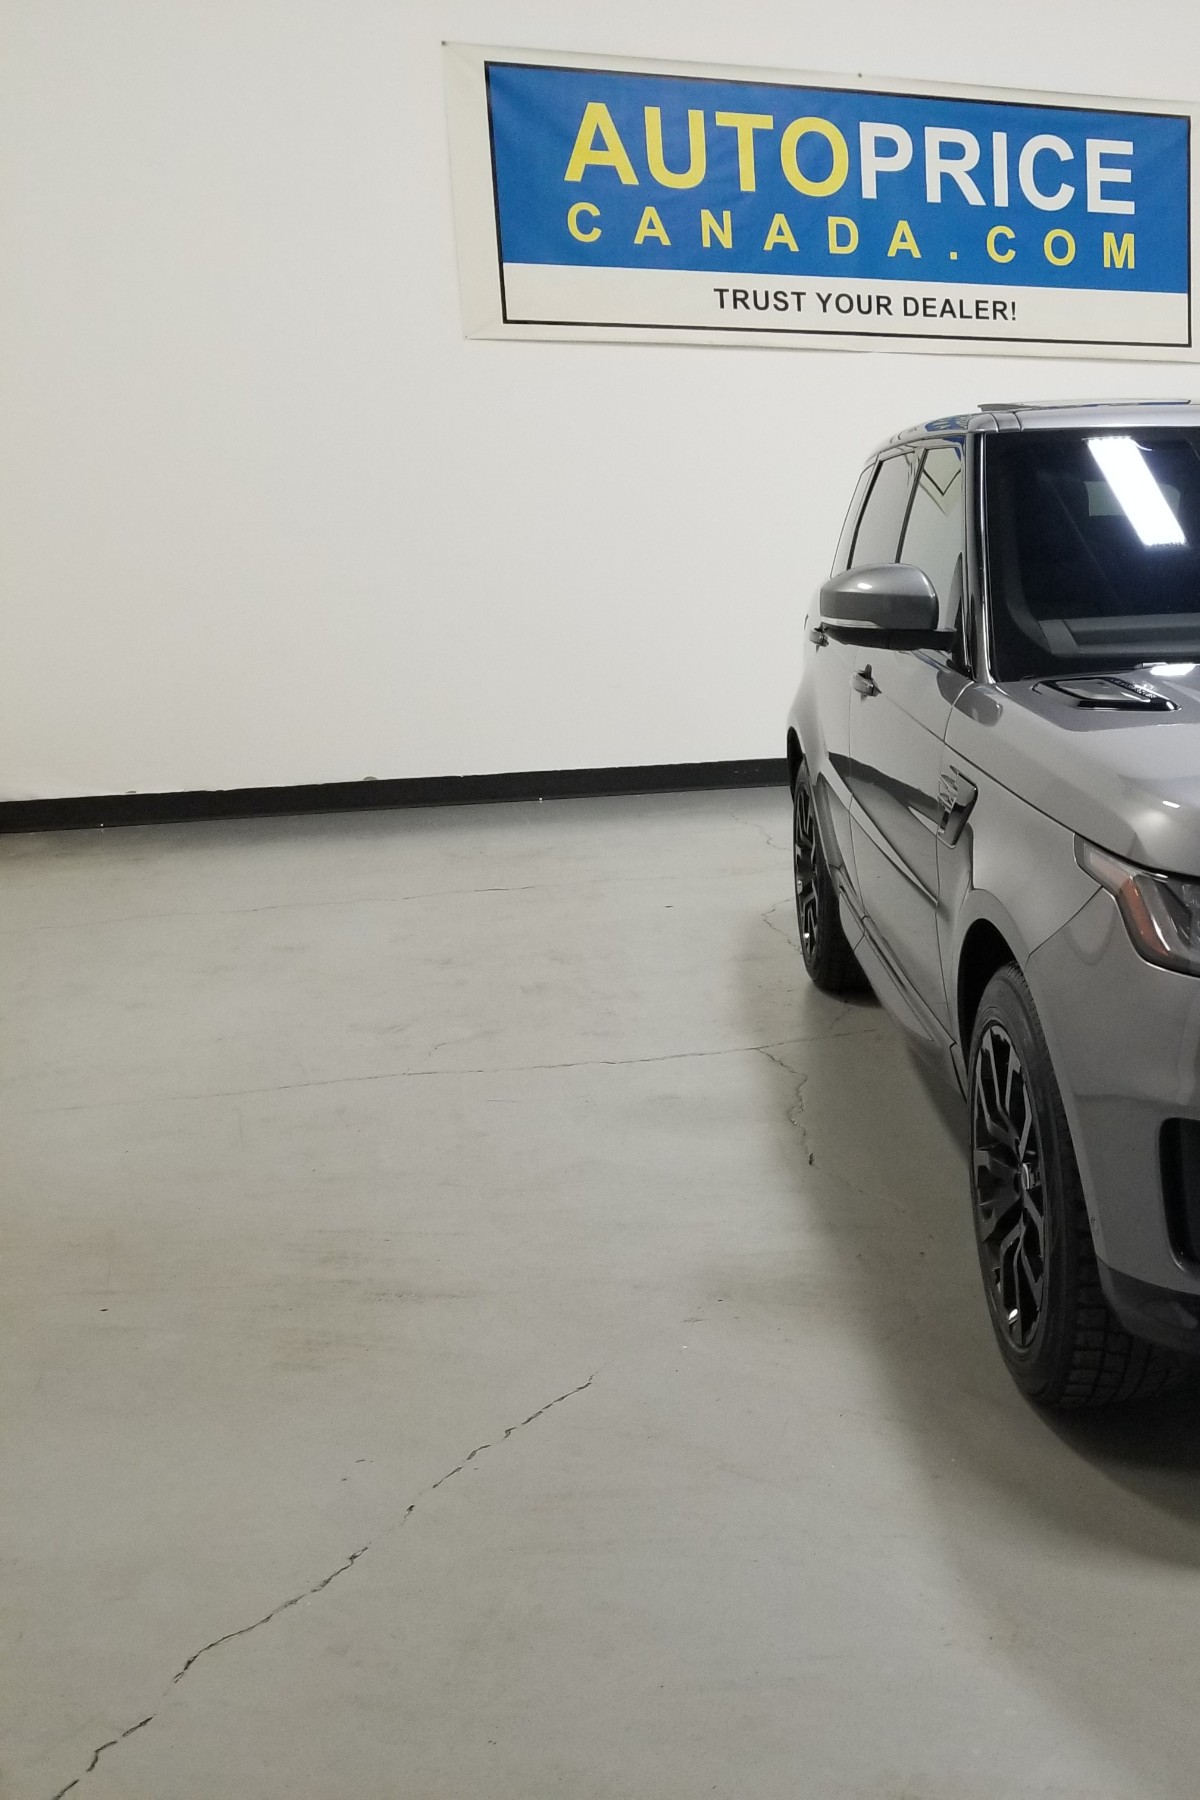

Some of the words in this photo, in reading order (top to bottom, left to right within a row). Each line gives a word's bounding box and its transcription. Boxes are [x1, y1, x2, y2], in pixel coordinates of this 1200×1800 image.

[564, 101, 1136, 215] AUTOPRICE
[566, 201, 1136, 269] CANADA.COM
[713, 288, 807, 313] TRUST
[815, 292, 893, 316] YOUR
[902, 296, 1017, 321] DEALER!
